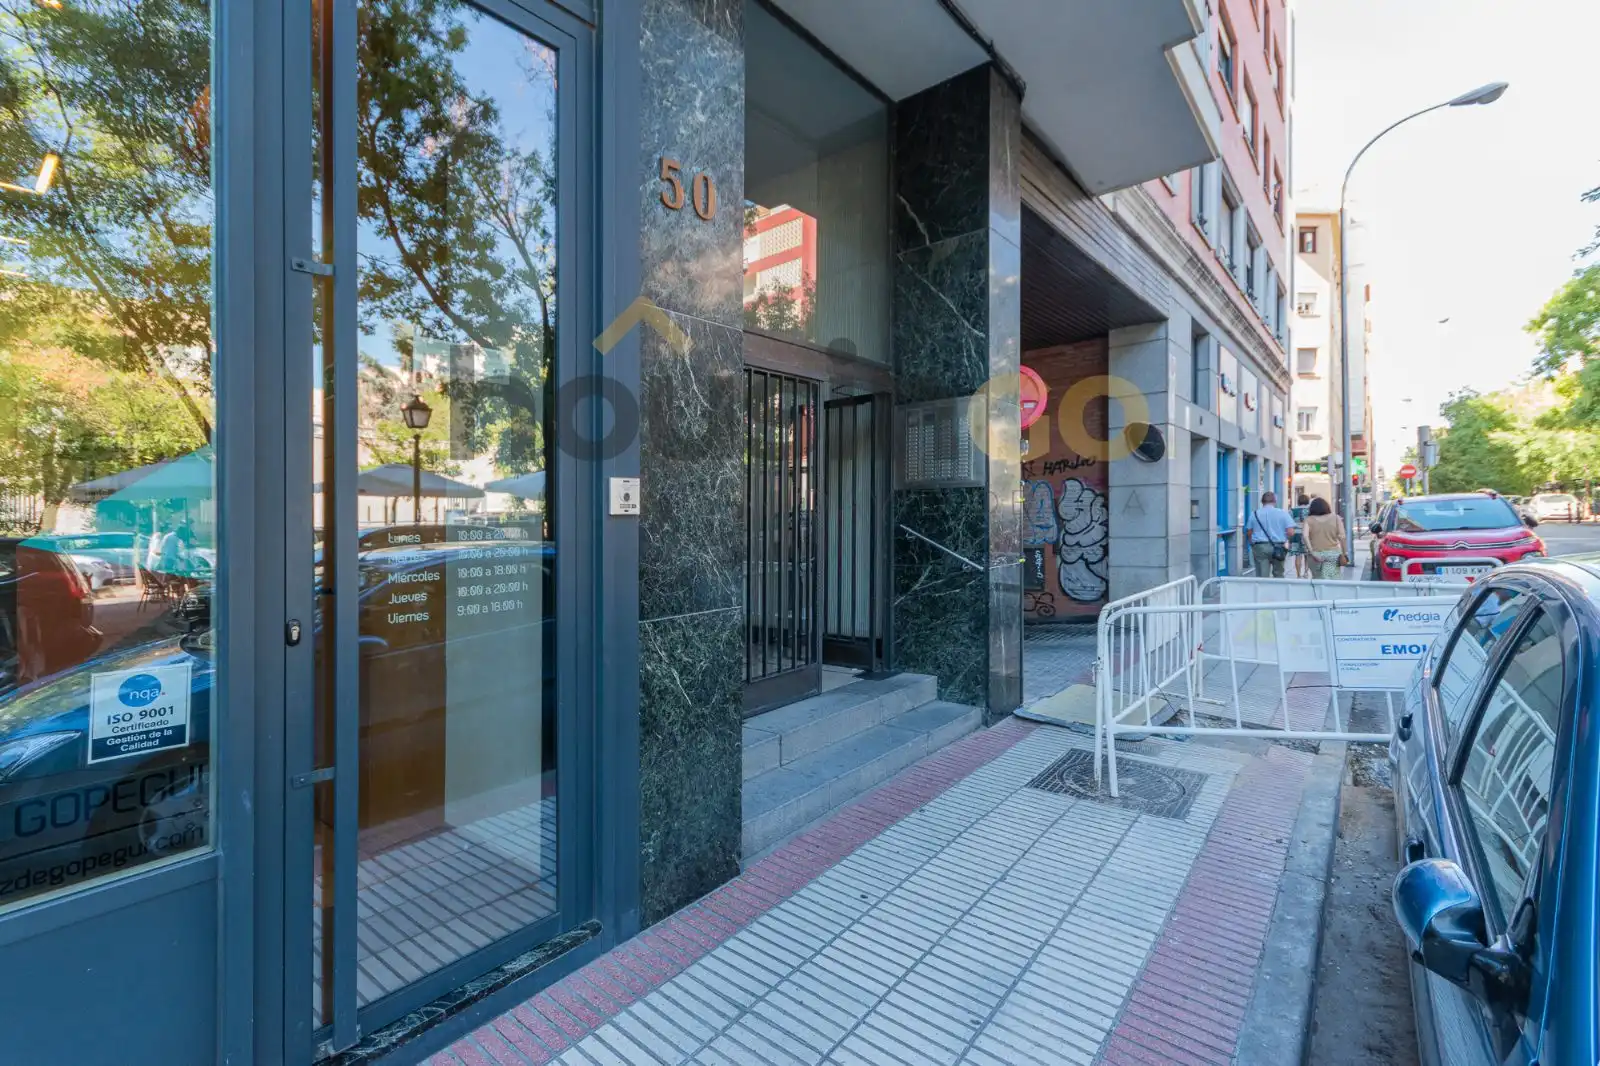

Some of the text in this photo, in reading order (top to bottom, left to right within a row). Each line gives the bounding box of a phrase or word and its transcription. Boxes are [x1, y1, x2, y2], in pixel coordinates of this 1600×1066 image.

[659, 156, 717, 220] 50
[388, 592, 428, 604] Jueves
[1398, 612, 1440, 622] nedgia
[107, 706, 174, 726] ISO 9001
[112, 719, 169, 734] Certificado
[106, 734, 146, 746] Gestión
[120, 739, 159, 752] Calidad
